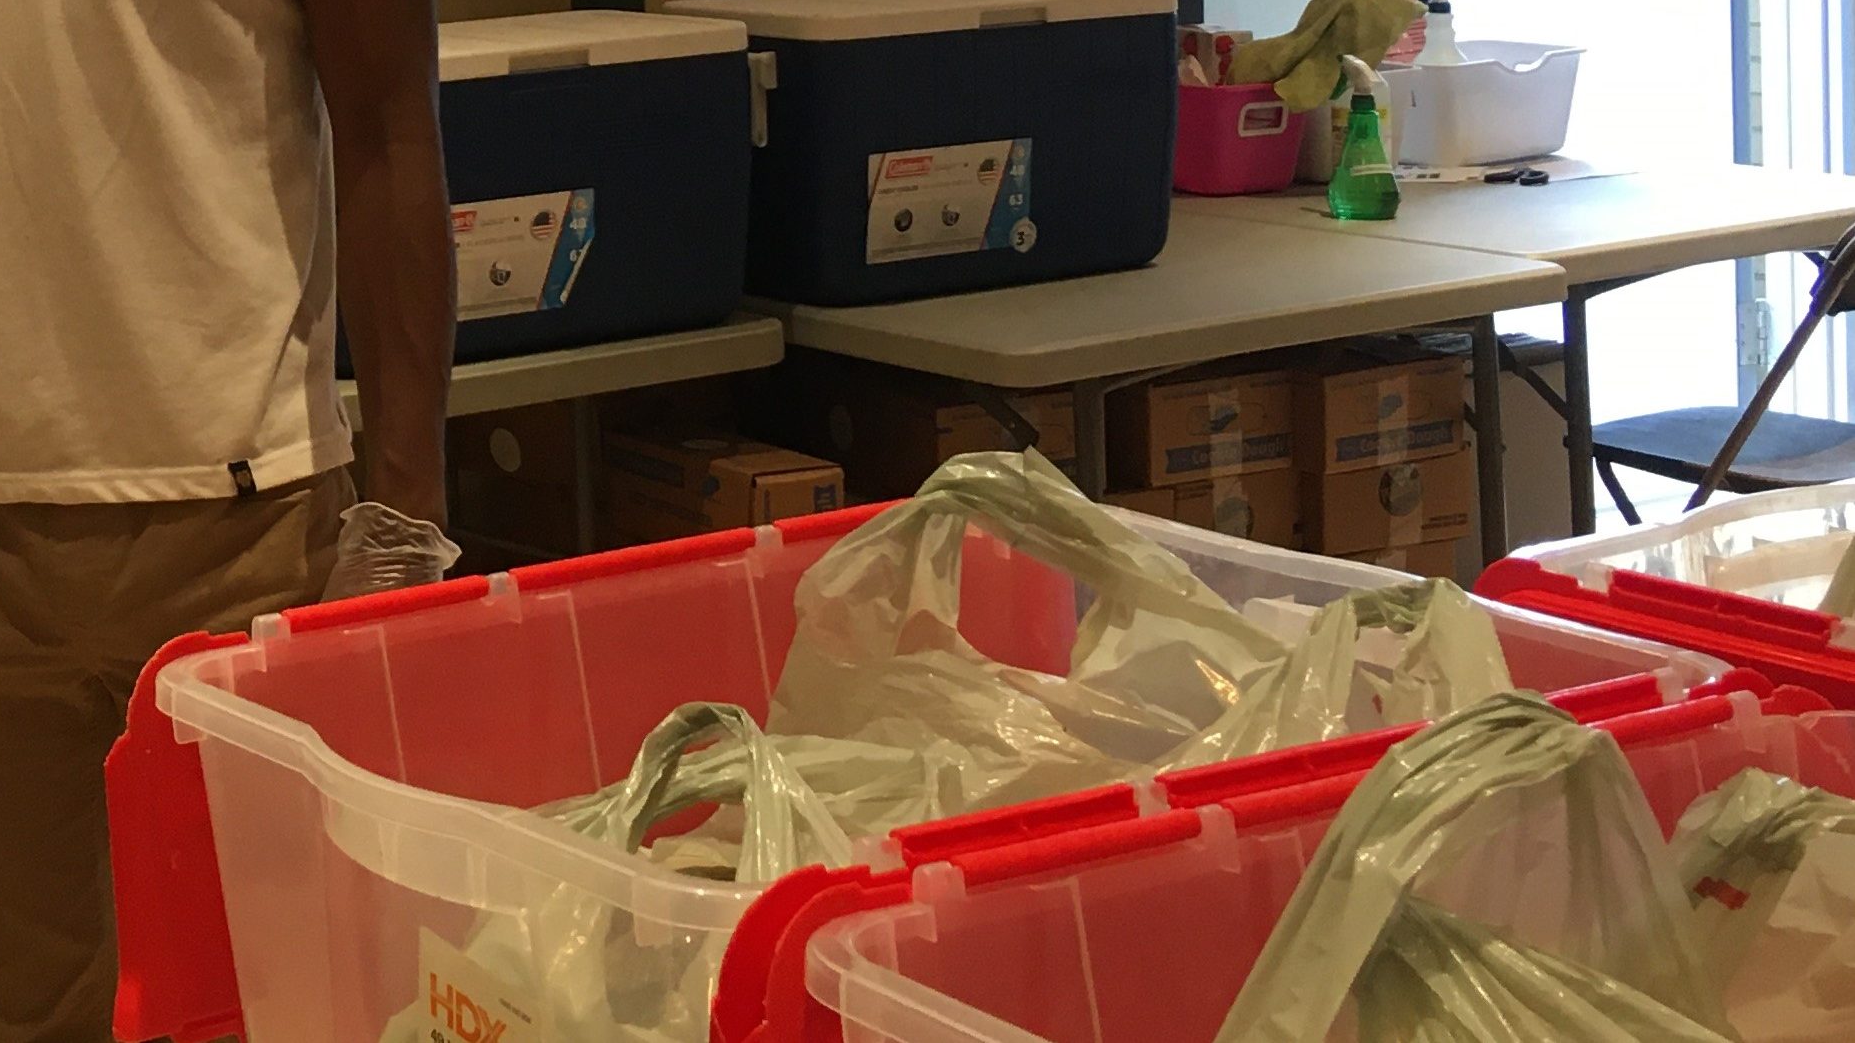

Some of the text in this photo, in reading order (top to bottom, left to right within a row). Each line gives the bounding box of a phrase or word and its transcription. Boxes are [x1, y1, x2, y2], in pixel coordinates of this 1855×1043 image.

[1009, 192, 1024, 206] 63
[1016, 231, 1025, 246] 3
[430, 972, 507, 1043] HDX
